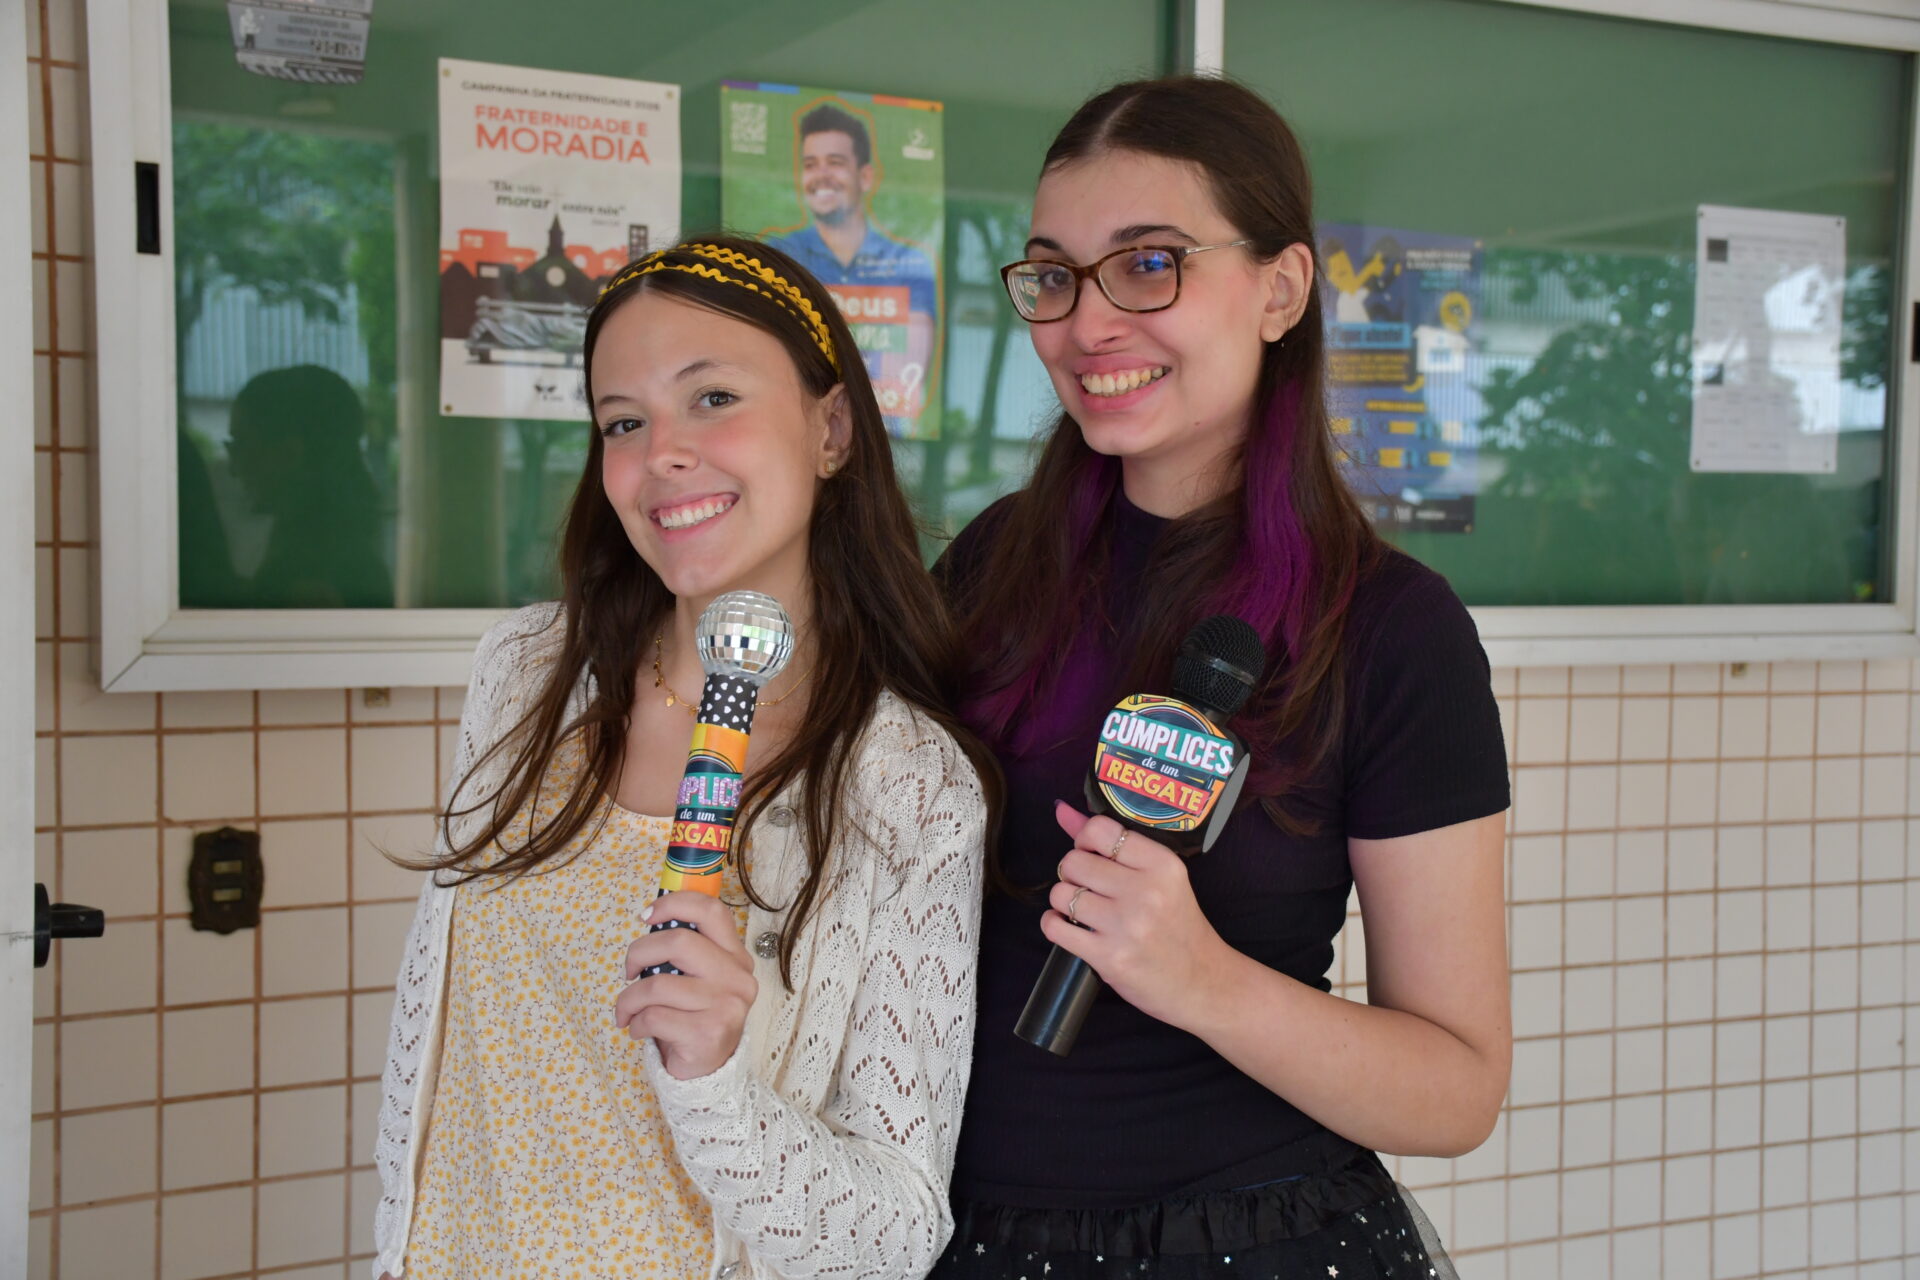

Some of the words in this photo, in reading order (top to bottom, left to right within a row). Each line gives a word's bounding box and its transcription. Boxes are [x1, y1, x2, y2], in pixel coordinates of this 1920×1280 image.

[461, 80, 529, 97] CAMPANHA
[550, 90, 632, 108] FRATERNIDADE
[474, 103, 630, 135] FRATERNIDADE
[637, 121, 649, 138] E
[475, 122, 651, 166] MORADIA
[496, 194, 551, 210] morar
[1102, 711, 1234, 775] CÚMPLICES
[1141, 756, 1157, 768] de
[1160, 763, 1180, 778] um
[1106, 759, 1204, 812] RESGATE
[680, 808, 693, 820] de
[697, 811, 717, 822] um
